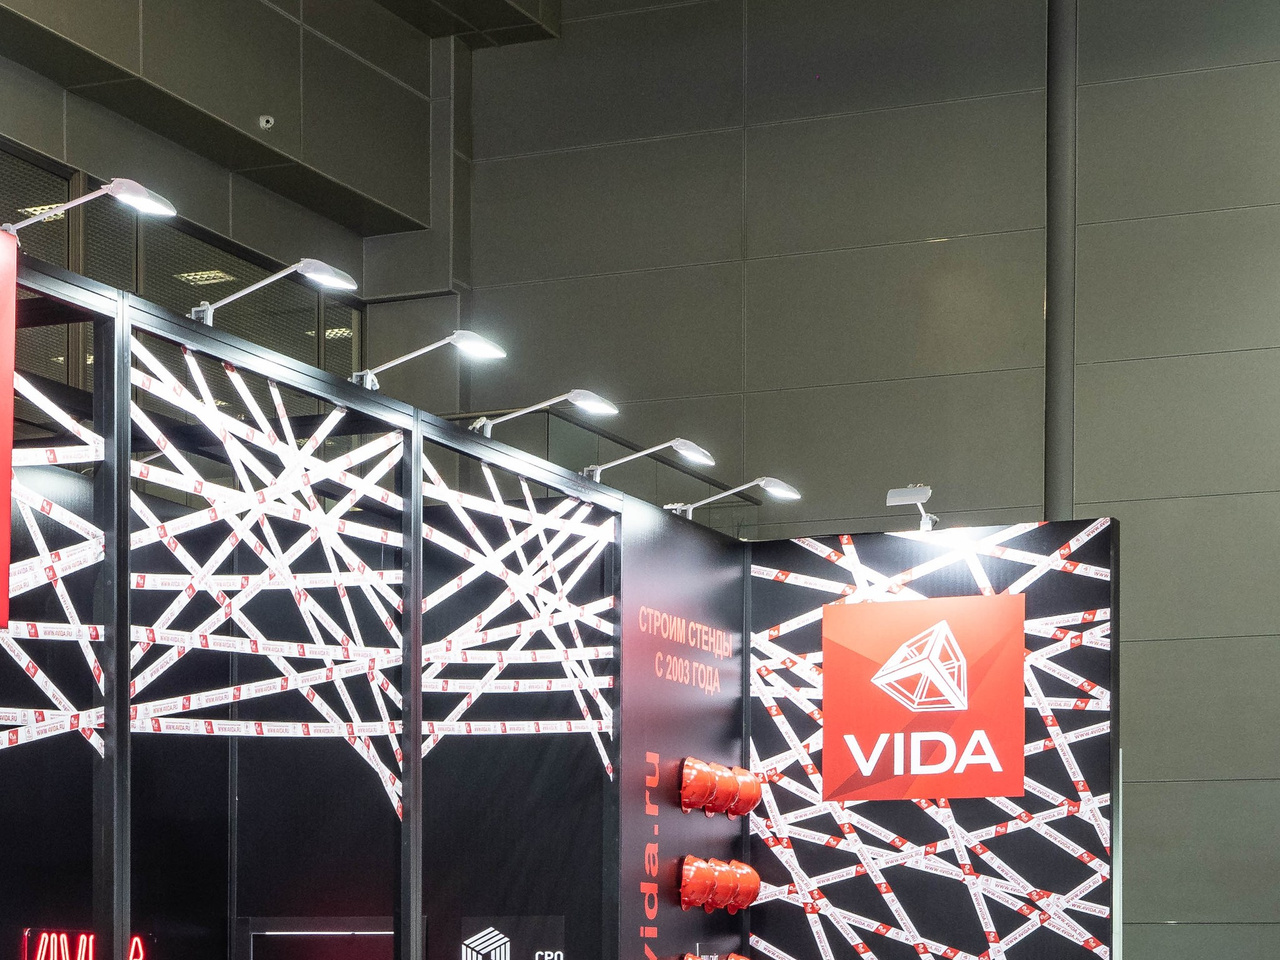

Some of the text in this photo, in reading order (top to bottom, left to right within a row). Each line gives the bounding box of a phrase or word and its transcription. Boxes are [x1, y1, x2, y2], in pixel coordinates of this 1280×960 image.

[639, 605, 733, 660] СТРОИМ СТЕНДЫ
[655, 651, 720, 696] С 2003 ГОДА
[843, 730, 1003, 777] VIDA
